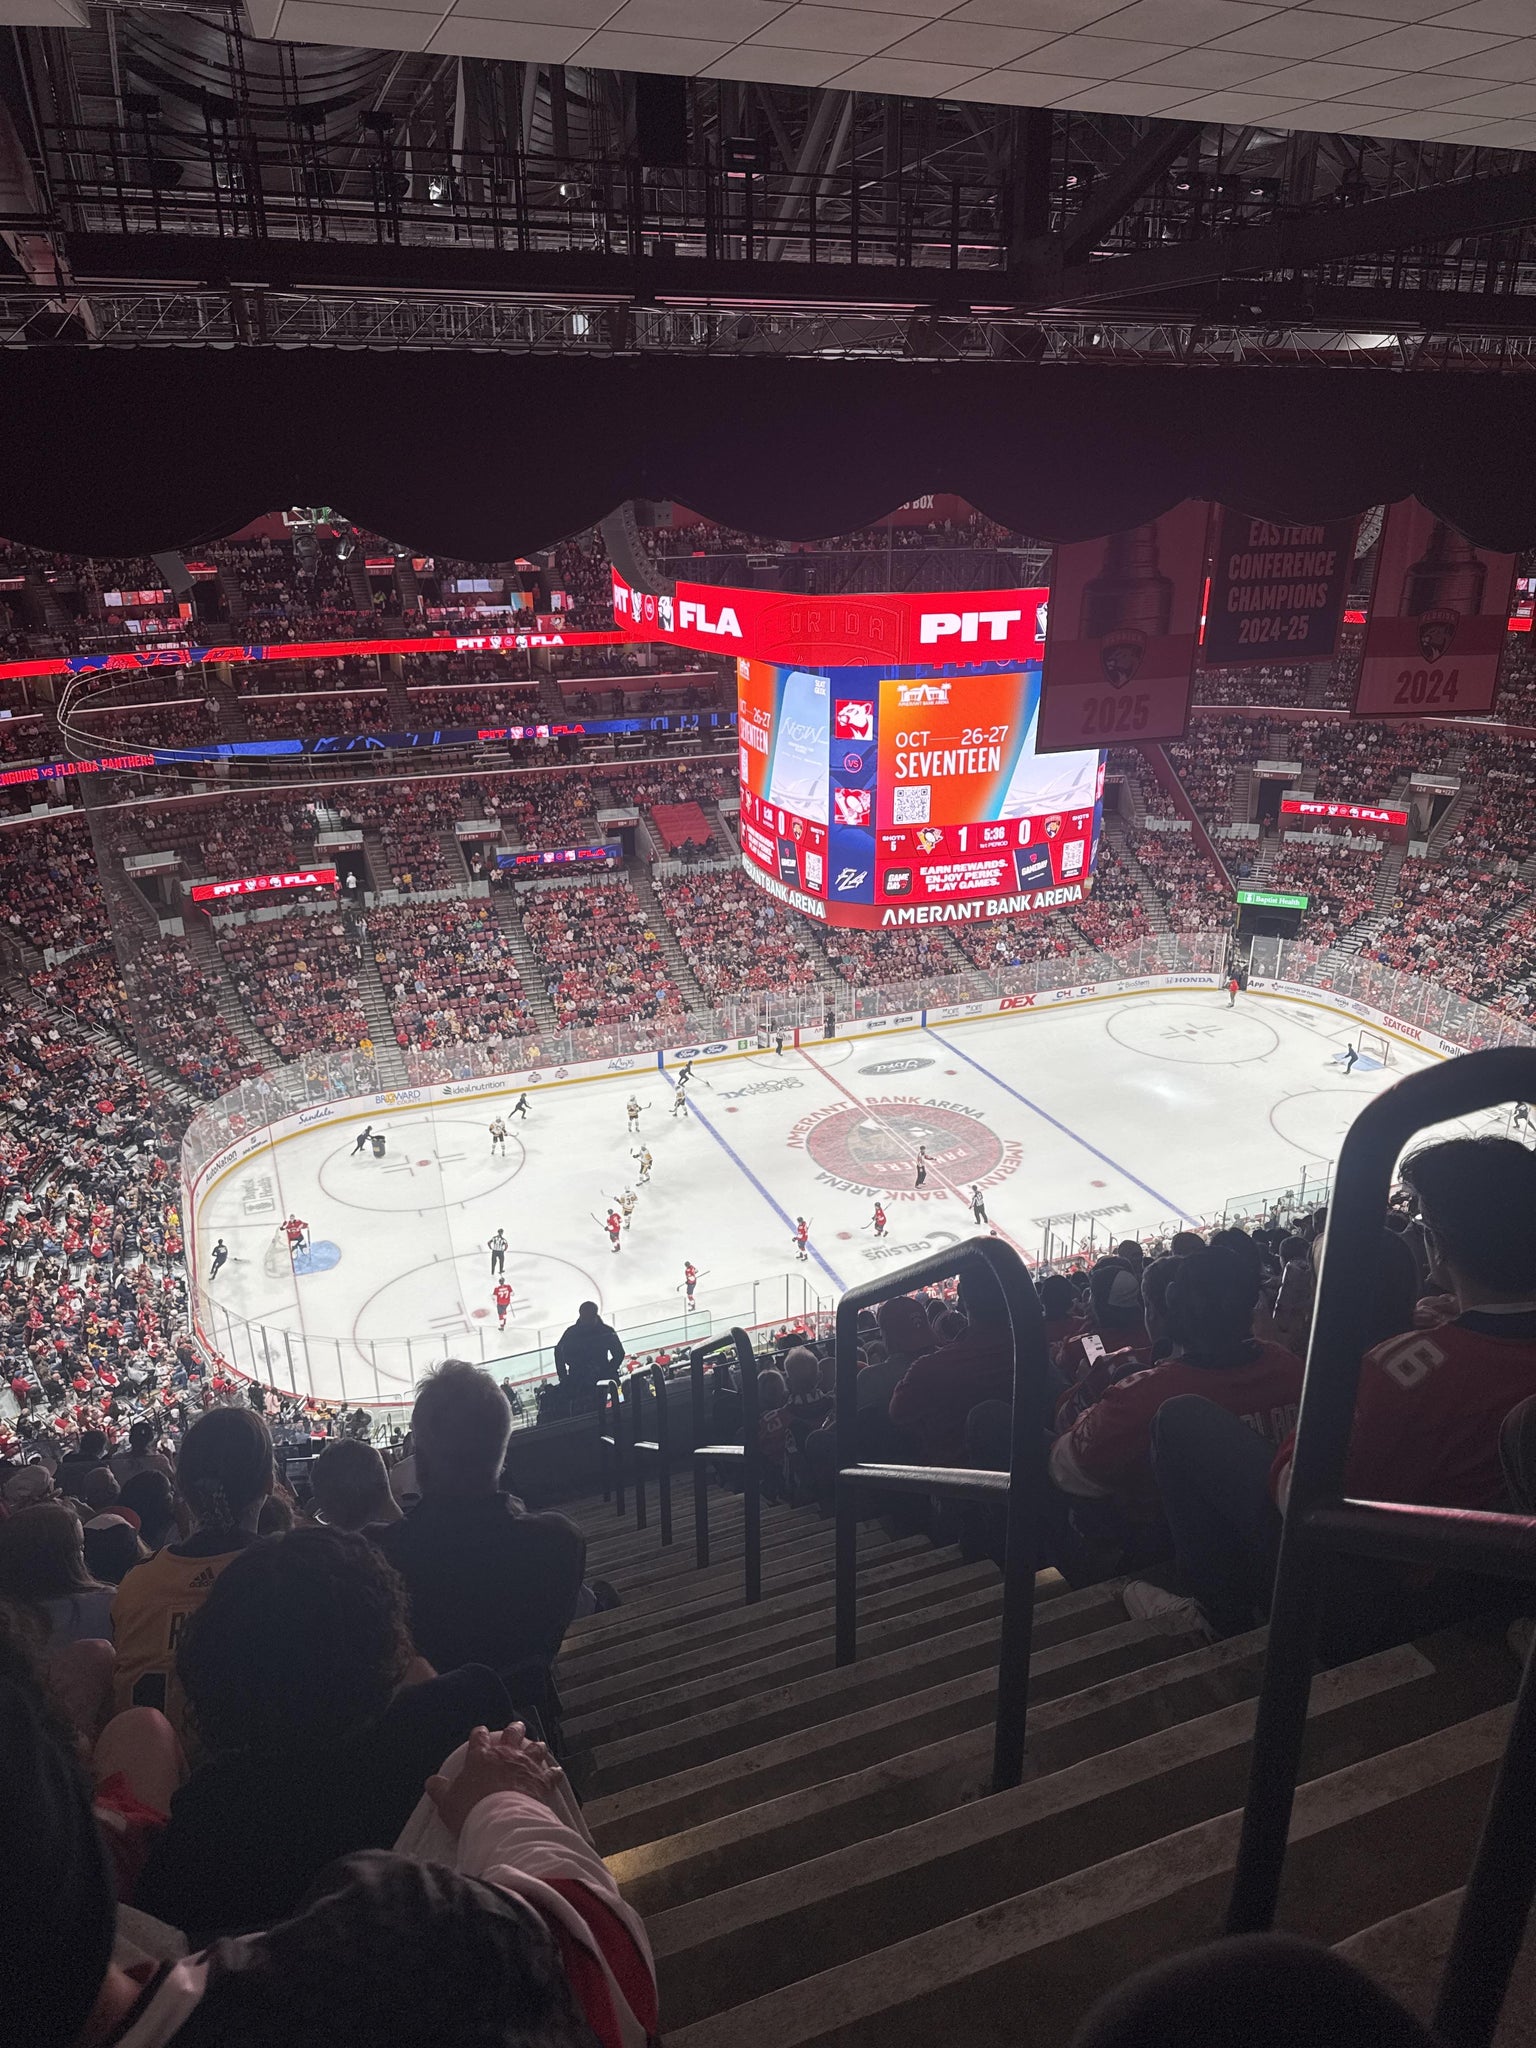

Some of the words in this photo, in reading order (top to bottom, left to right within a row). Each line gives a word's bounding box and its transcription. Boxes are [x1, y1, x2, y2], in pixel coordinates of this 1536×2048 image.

[1248, 520, 1325, 547] EASTERN
[1228, 550, 1336, 580] CONFERENCE
[1227, 582, 1328, 613] CHAMPIONS
[679, 600, 743, 638] FLA
[920, 610, 1022, 644] PIT
[1238, 615, 1309, 644] 2024-25
[456, 638, 486, 649] PIT
[530, 635, 565, 645] FLA
[1393, 668, 1460, 705] 2024
[1081, 694, 1150, 735] 2025
[895, 731, 931, 748] OCT
[961, 725, 1009, 746] 26-27
[101, 753, 156, 771] PANTHERS
[895, 745, 1001, 779] SEVENTEEN
[1300, 804, 1325, 813] PIT
[1361, 811, 1390, 821] FLA
[957, 826, 968, 852] 1
[1018, 819, 1032, 845] 0
[920, 864, 951, 876] EARN
[952, 858, 1009, 873] REWARDS.
[925, 872, 963, 885] ENJOY
[214, 883, 241, 895] PIT
[285, 874, 317, 885] FLA
[927, 883, 958, 894] PLAY
[788, 890, 827, 919] ARENA
[881, 901, 984, 926] AMERANT
[986, 895, 1031, 917] BANK
[1032, 884, 1083, 910] ARENA
[1255, 895, 1278, 904] Baptist
[1279, 897, 1300, 906] Health
[1174, 976, 1214, 984] HONDA
[1000, 992, 1038, 1011] DEX
[1382, 1015, 1422, 1042] SEATGEEK
[875, 1058, 919, 1073] Ford
[786, 1101, 849, 1150] AMERANT
[865, 1095, 922, 1105] BANK
[924, 1098, 986, 1120] ARENA
[204, 1150, 238, 1185] AutoNation
[813, 1171, 881, 1199] ARENA
[883, 1189, 949, 1202] BANK
[864, 1240, 931, 1261] CELSIUS
[1381, 1338, 1448, 1390] 6
